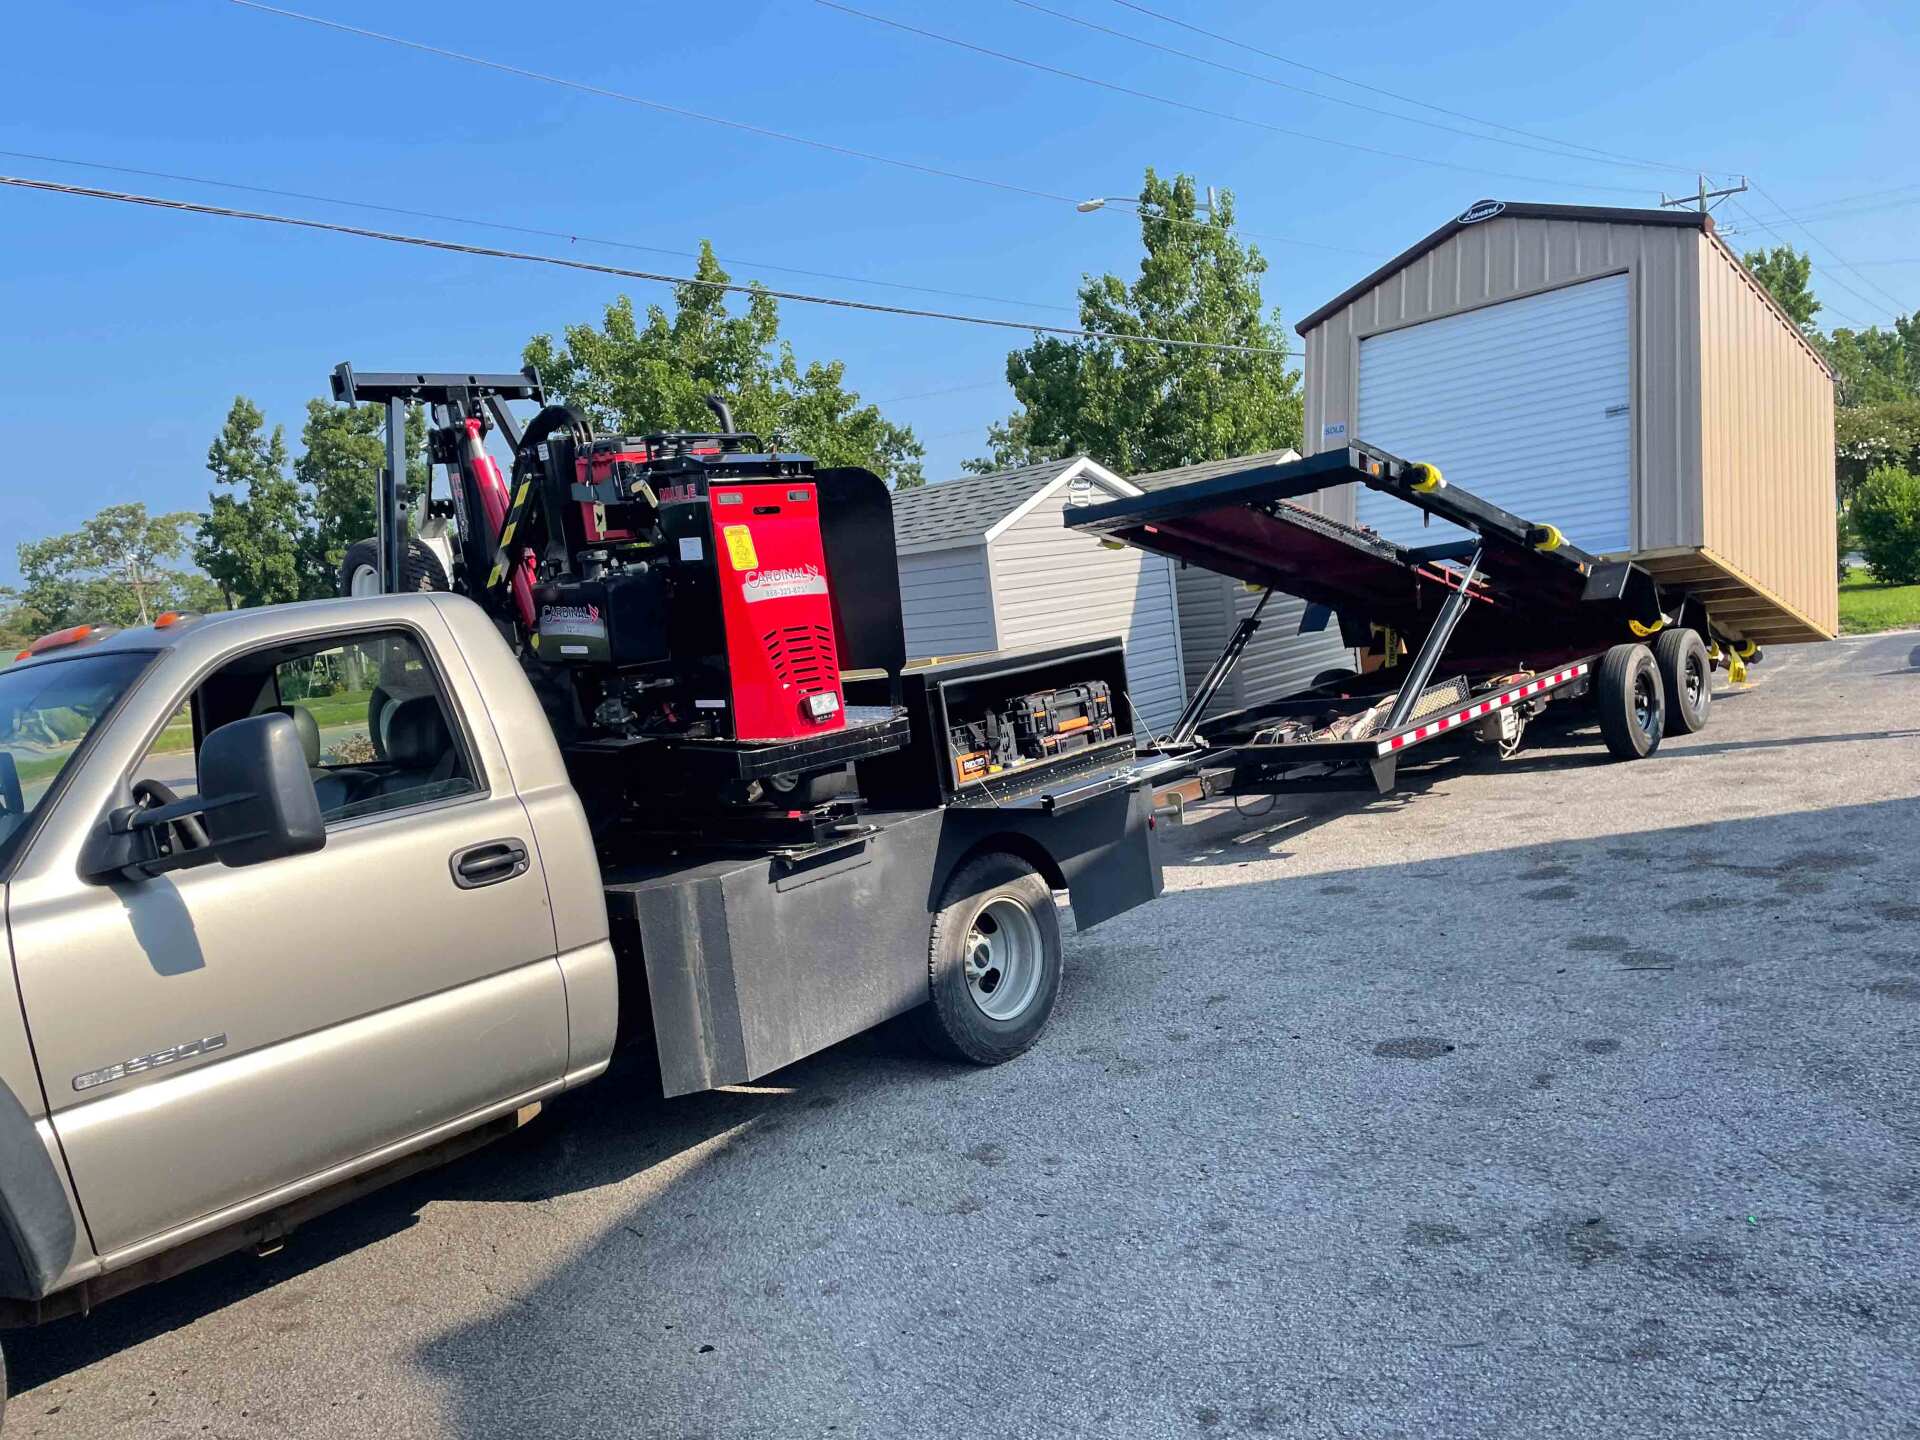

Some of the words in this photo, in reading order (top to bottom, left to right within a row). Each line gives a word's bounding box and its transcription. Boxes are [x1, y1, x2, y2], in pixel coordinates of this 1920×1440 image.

[1325, 424, 1345, 435] SOLD
[659, 484, 697, 504] MULE
[745, 567, 808, 588] CARDINAL
[542, 605, 591, 624] CARDINAL
